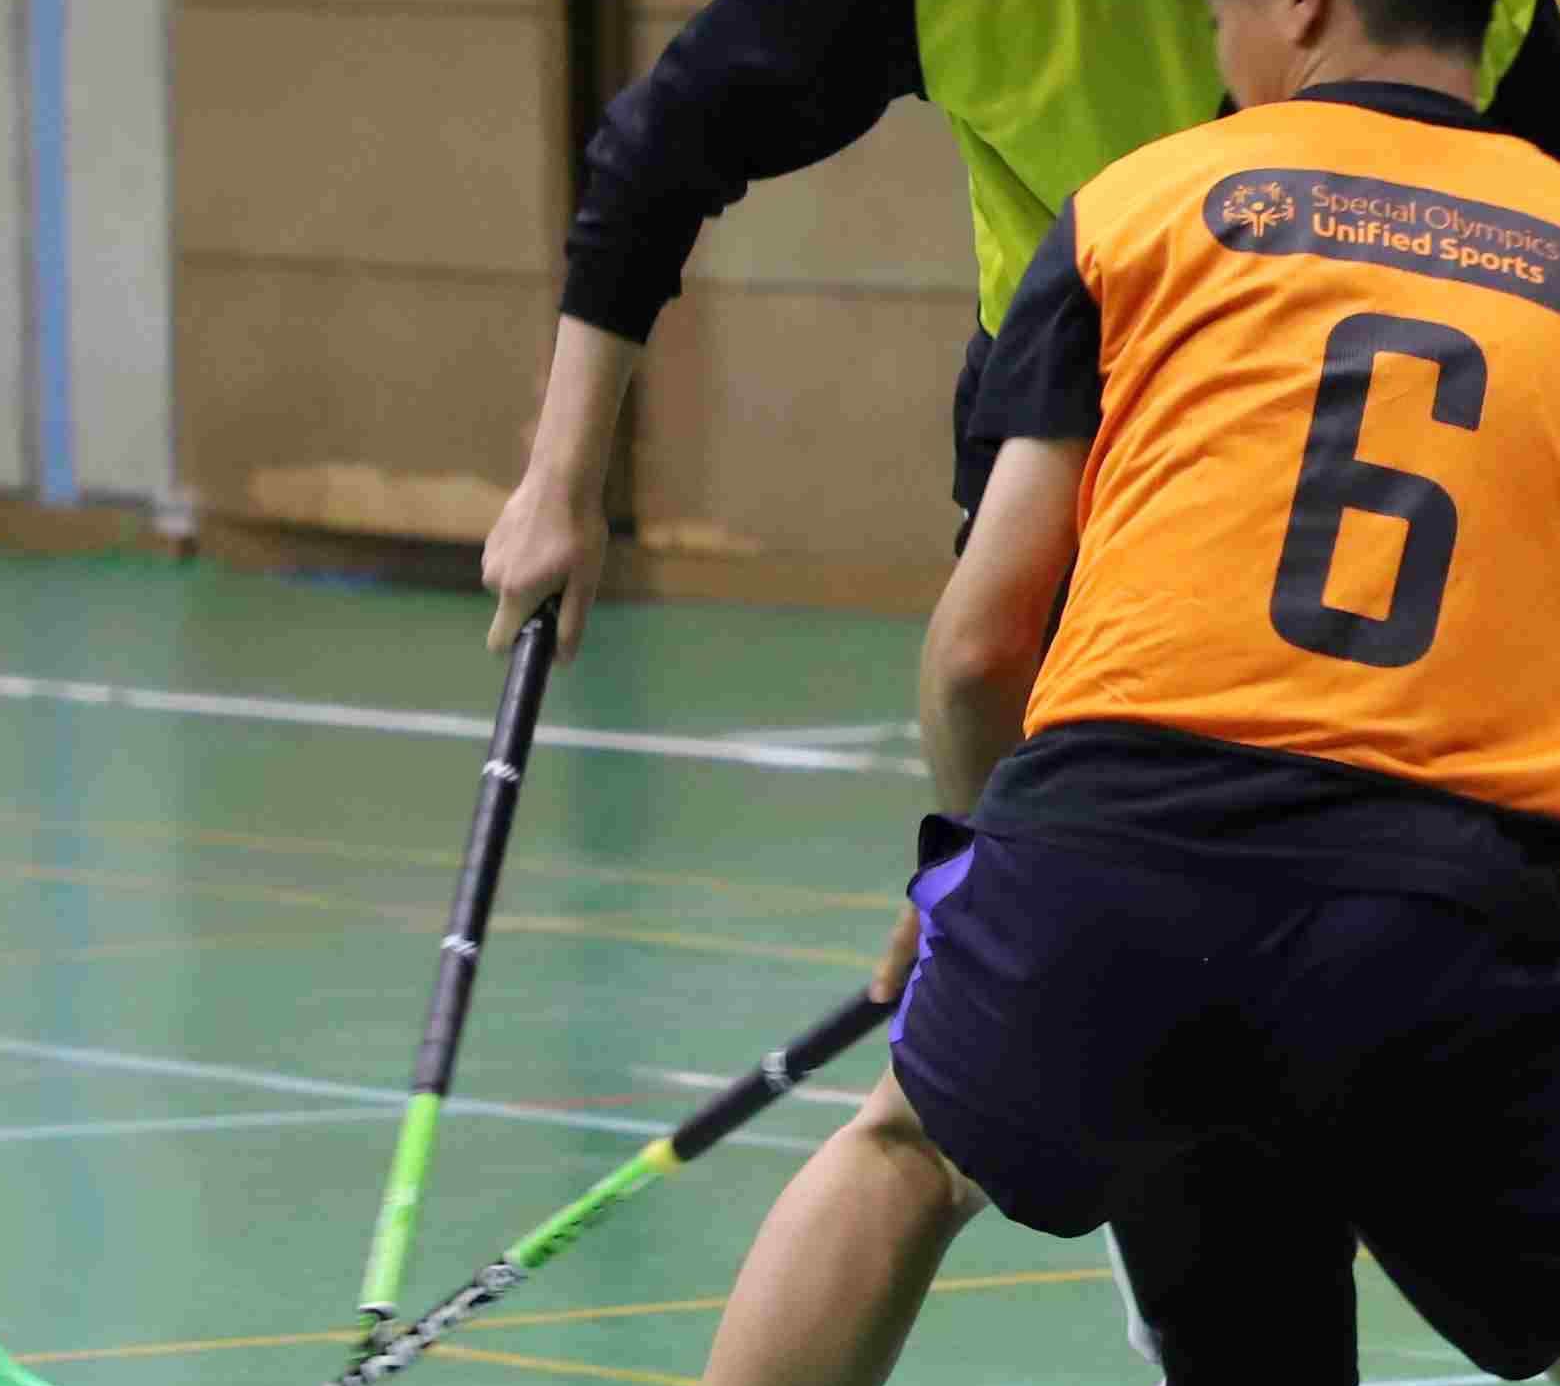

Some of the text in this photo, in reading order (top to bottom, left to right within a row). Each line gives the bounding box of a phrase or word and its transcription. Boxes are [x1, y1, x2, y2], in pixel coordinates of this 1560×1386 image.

[1311, 182, 1560, 261] Special Olympics
[1313, 212, 1545, 284] Unified Sports
[1269, 312, 1488, 667] 6
